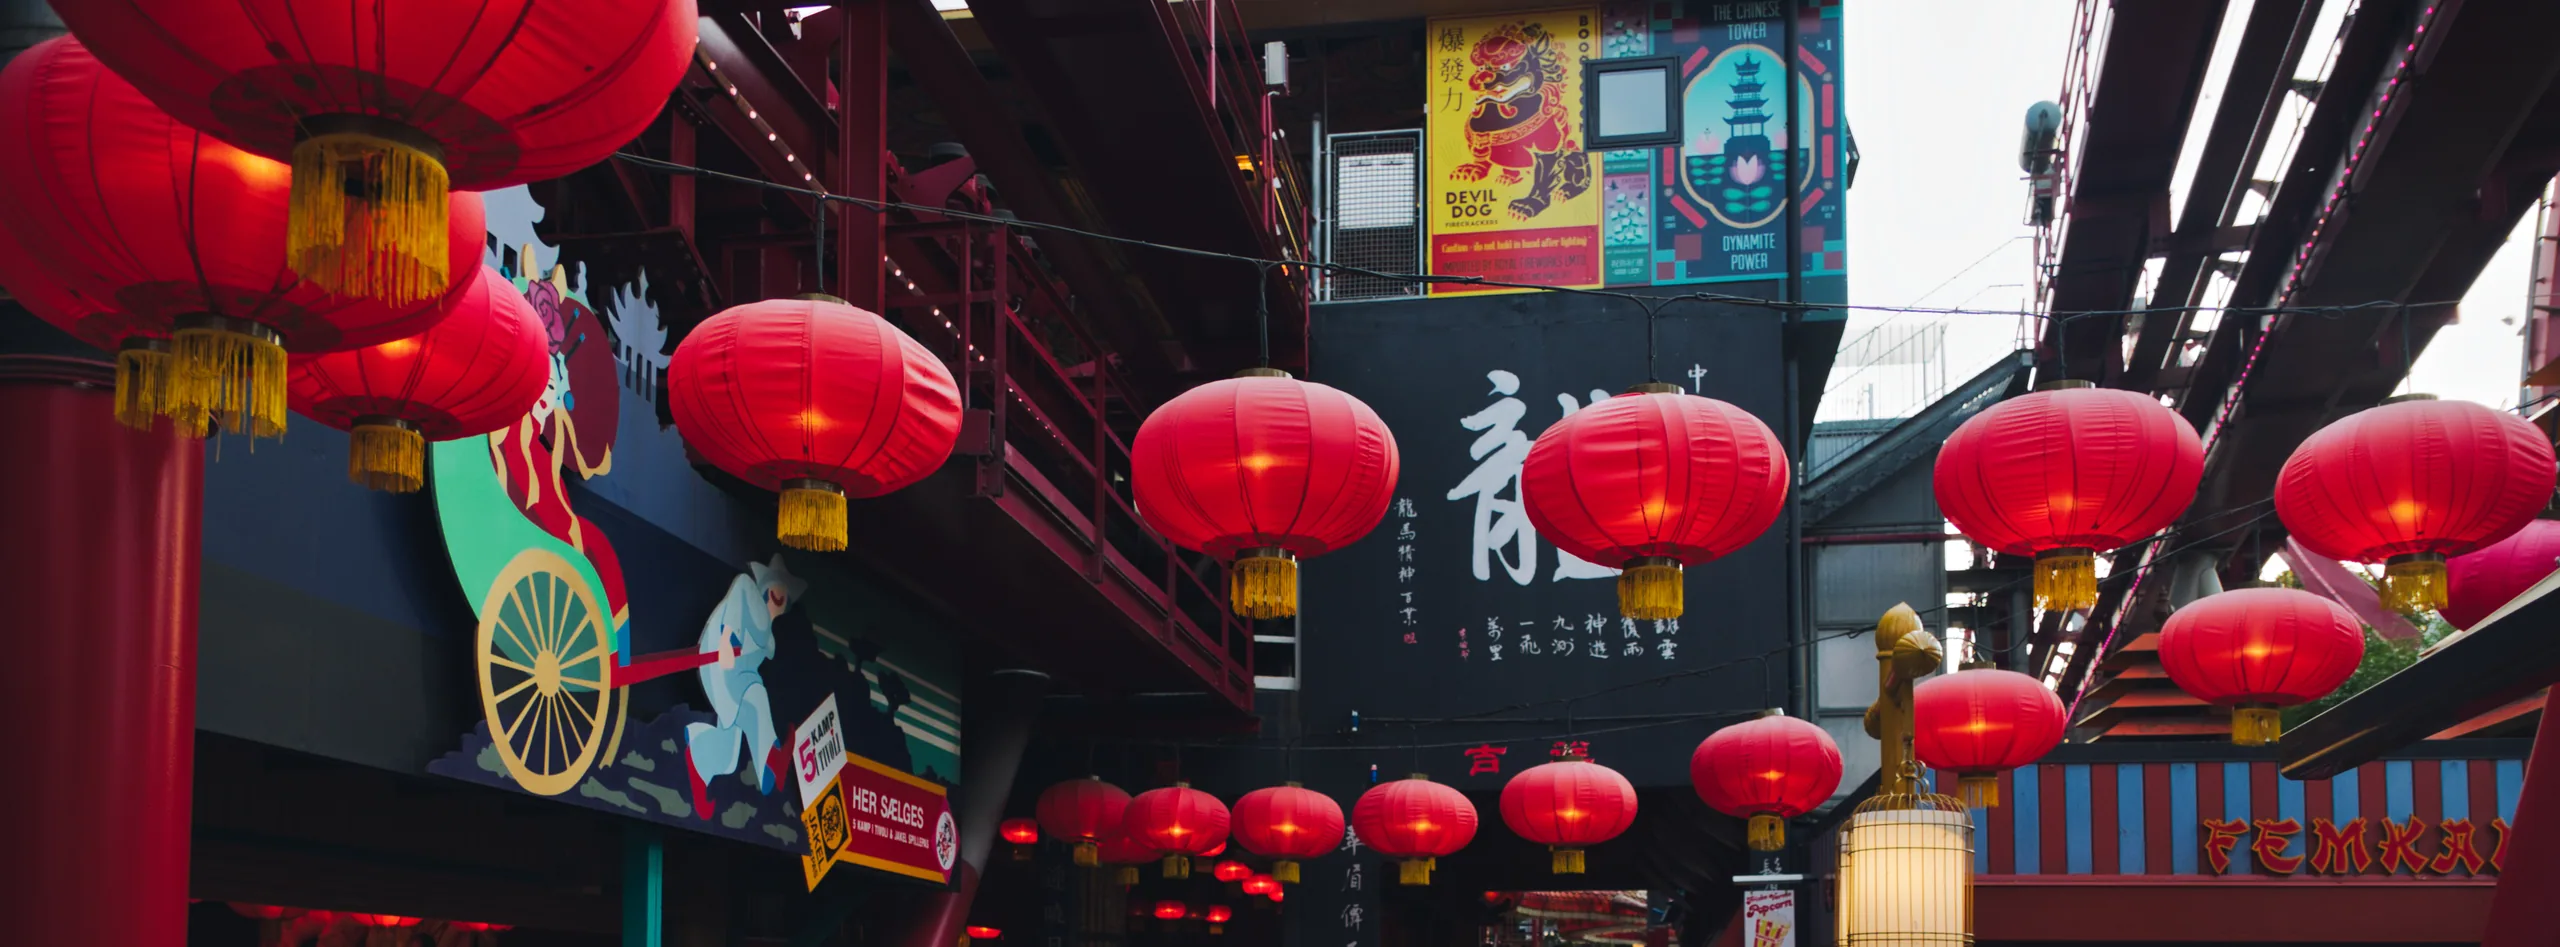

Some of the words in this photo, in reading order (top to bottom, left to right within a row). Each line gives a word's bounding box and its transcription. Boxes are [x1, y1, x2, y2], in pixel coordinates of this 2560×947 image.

[1713, 4, 1732, 21] THE
[1736, 1, 1782, 20] CHINESE
[1727, 22, 1767, 41] TOWER
[1438, 26, 1465, 113] 爆發力
[1446, 189, 1498, 205] DEVIL
[1452, 204, 1493, 219] DOG
[1445, 219, 1499, 229] FIRECRACKERS
[1723, 233, 1776, 252] DYNAMITE
[1731, 253, 1768, 271] POWER
[1688, 363, 1708, 394] 中
[811, 711, 835, 746] KAMP
[818, 731, 842, 772] TIVOLI
[853, 786, 877, 815] HER
[880, 795, 924, 829] SÆLGES
[857, 820, 871, 833] KAMP
[874, 824, 889, 838] TIVOLI
[808, 812, 825, 873] JAKEL
[1746, 899, 1793, 918] Popcorn
